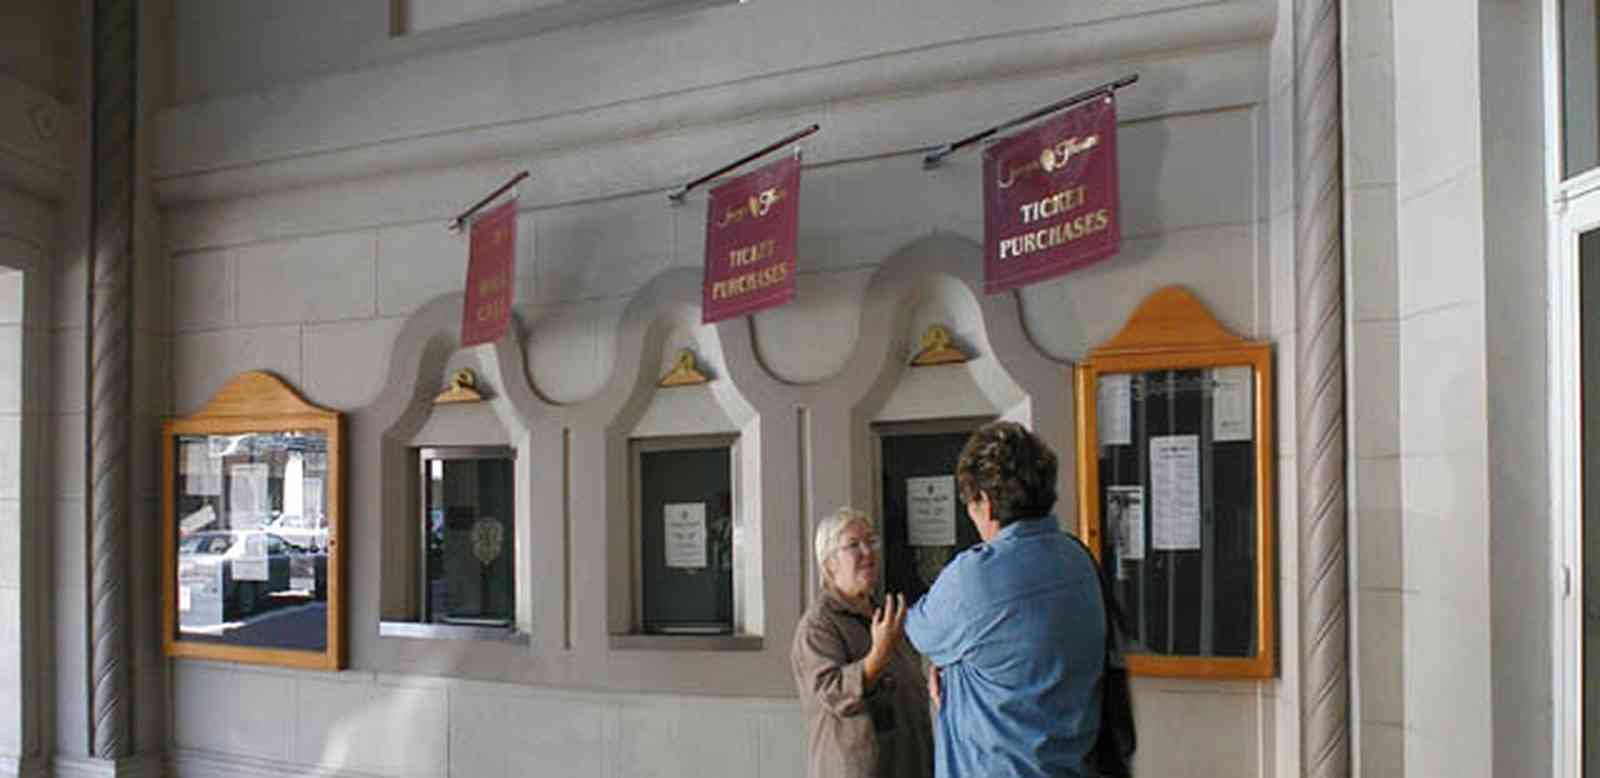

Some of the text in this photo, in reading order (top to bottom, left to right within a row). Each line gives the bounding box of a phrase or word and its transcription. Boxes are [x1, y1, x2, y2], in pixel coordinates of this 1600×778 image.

[1020, 185, 1088, 224] TICKET
[999, 209, 1108, 259] PURCHASES
[729, 239, 776, 269] TICKET
[712, 262, 787, 302] PURCHASES
